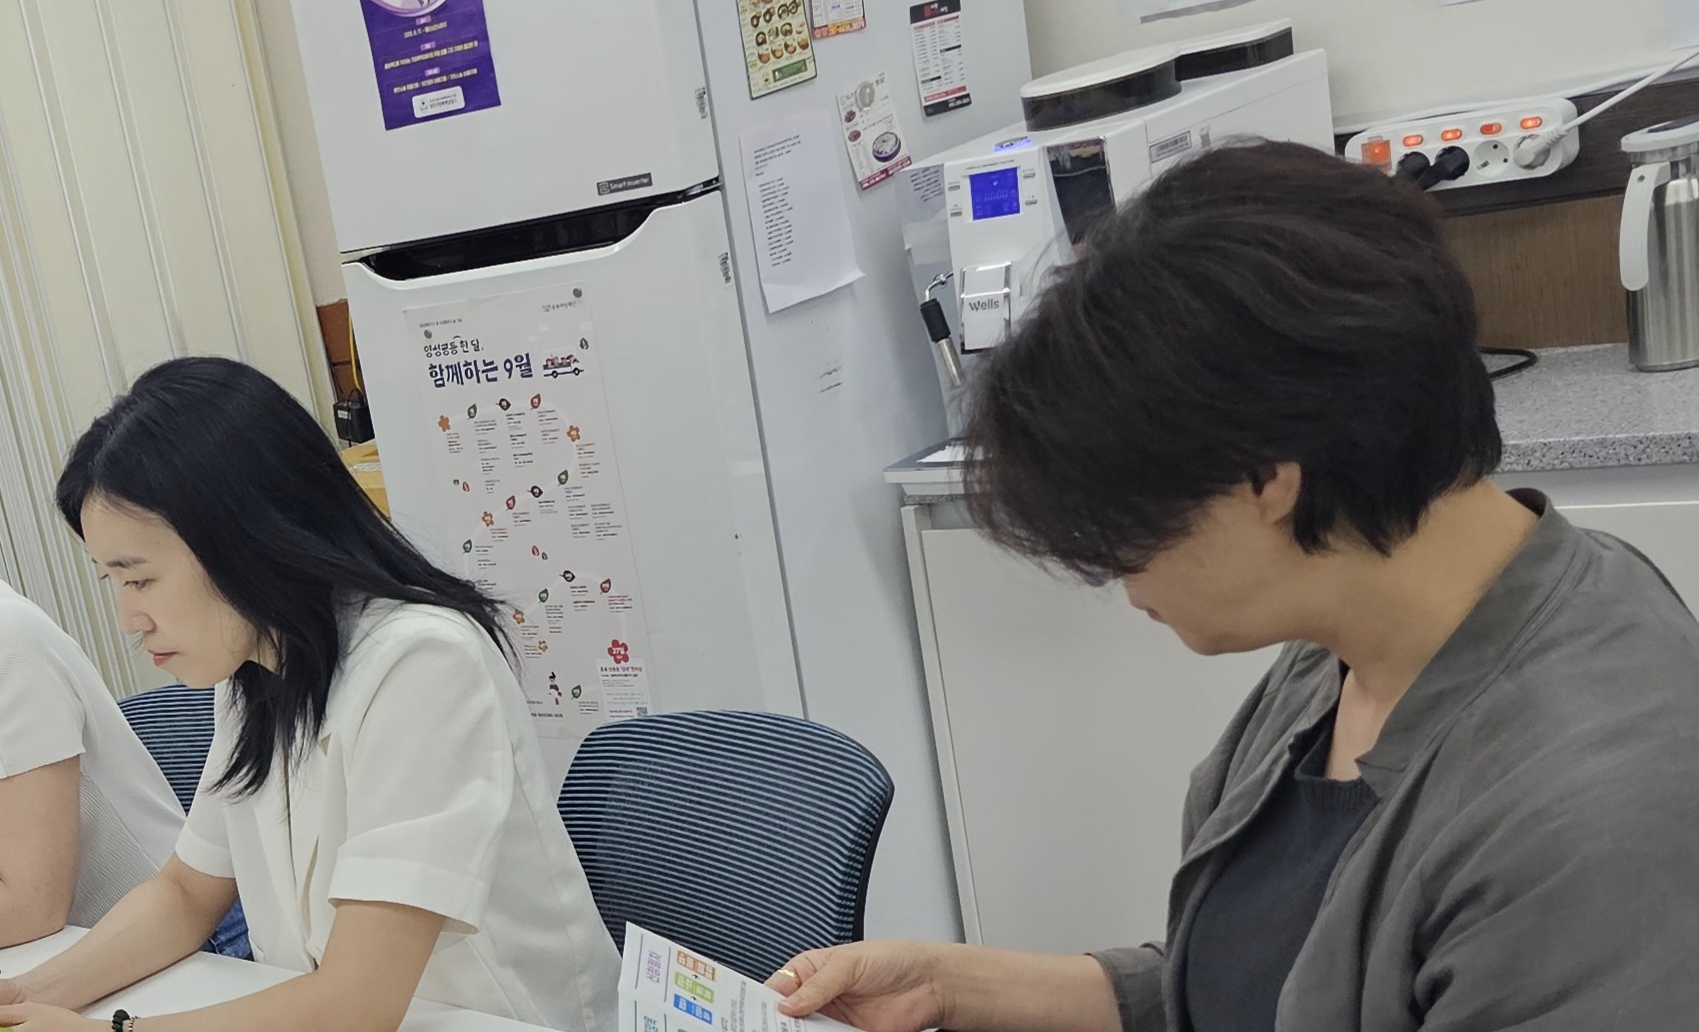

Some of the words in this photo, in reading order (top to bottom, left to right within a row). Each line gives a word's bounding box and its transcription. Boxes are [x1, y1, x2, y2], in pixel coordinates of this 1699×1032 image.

[968, 298, 1000, 312] Wells
[459, 340, 470, 353] 한
[428, 358, 499, 388] 함께하는
[503, 353, 533, 379] 9월
